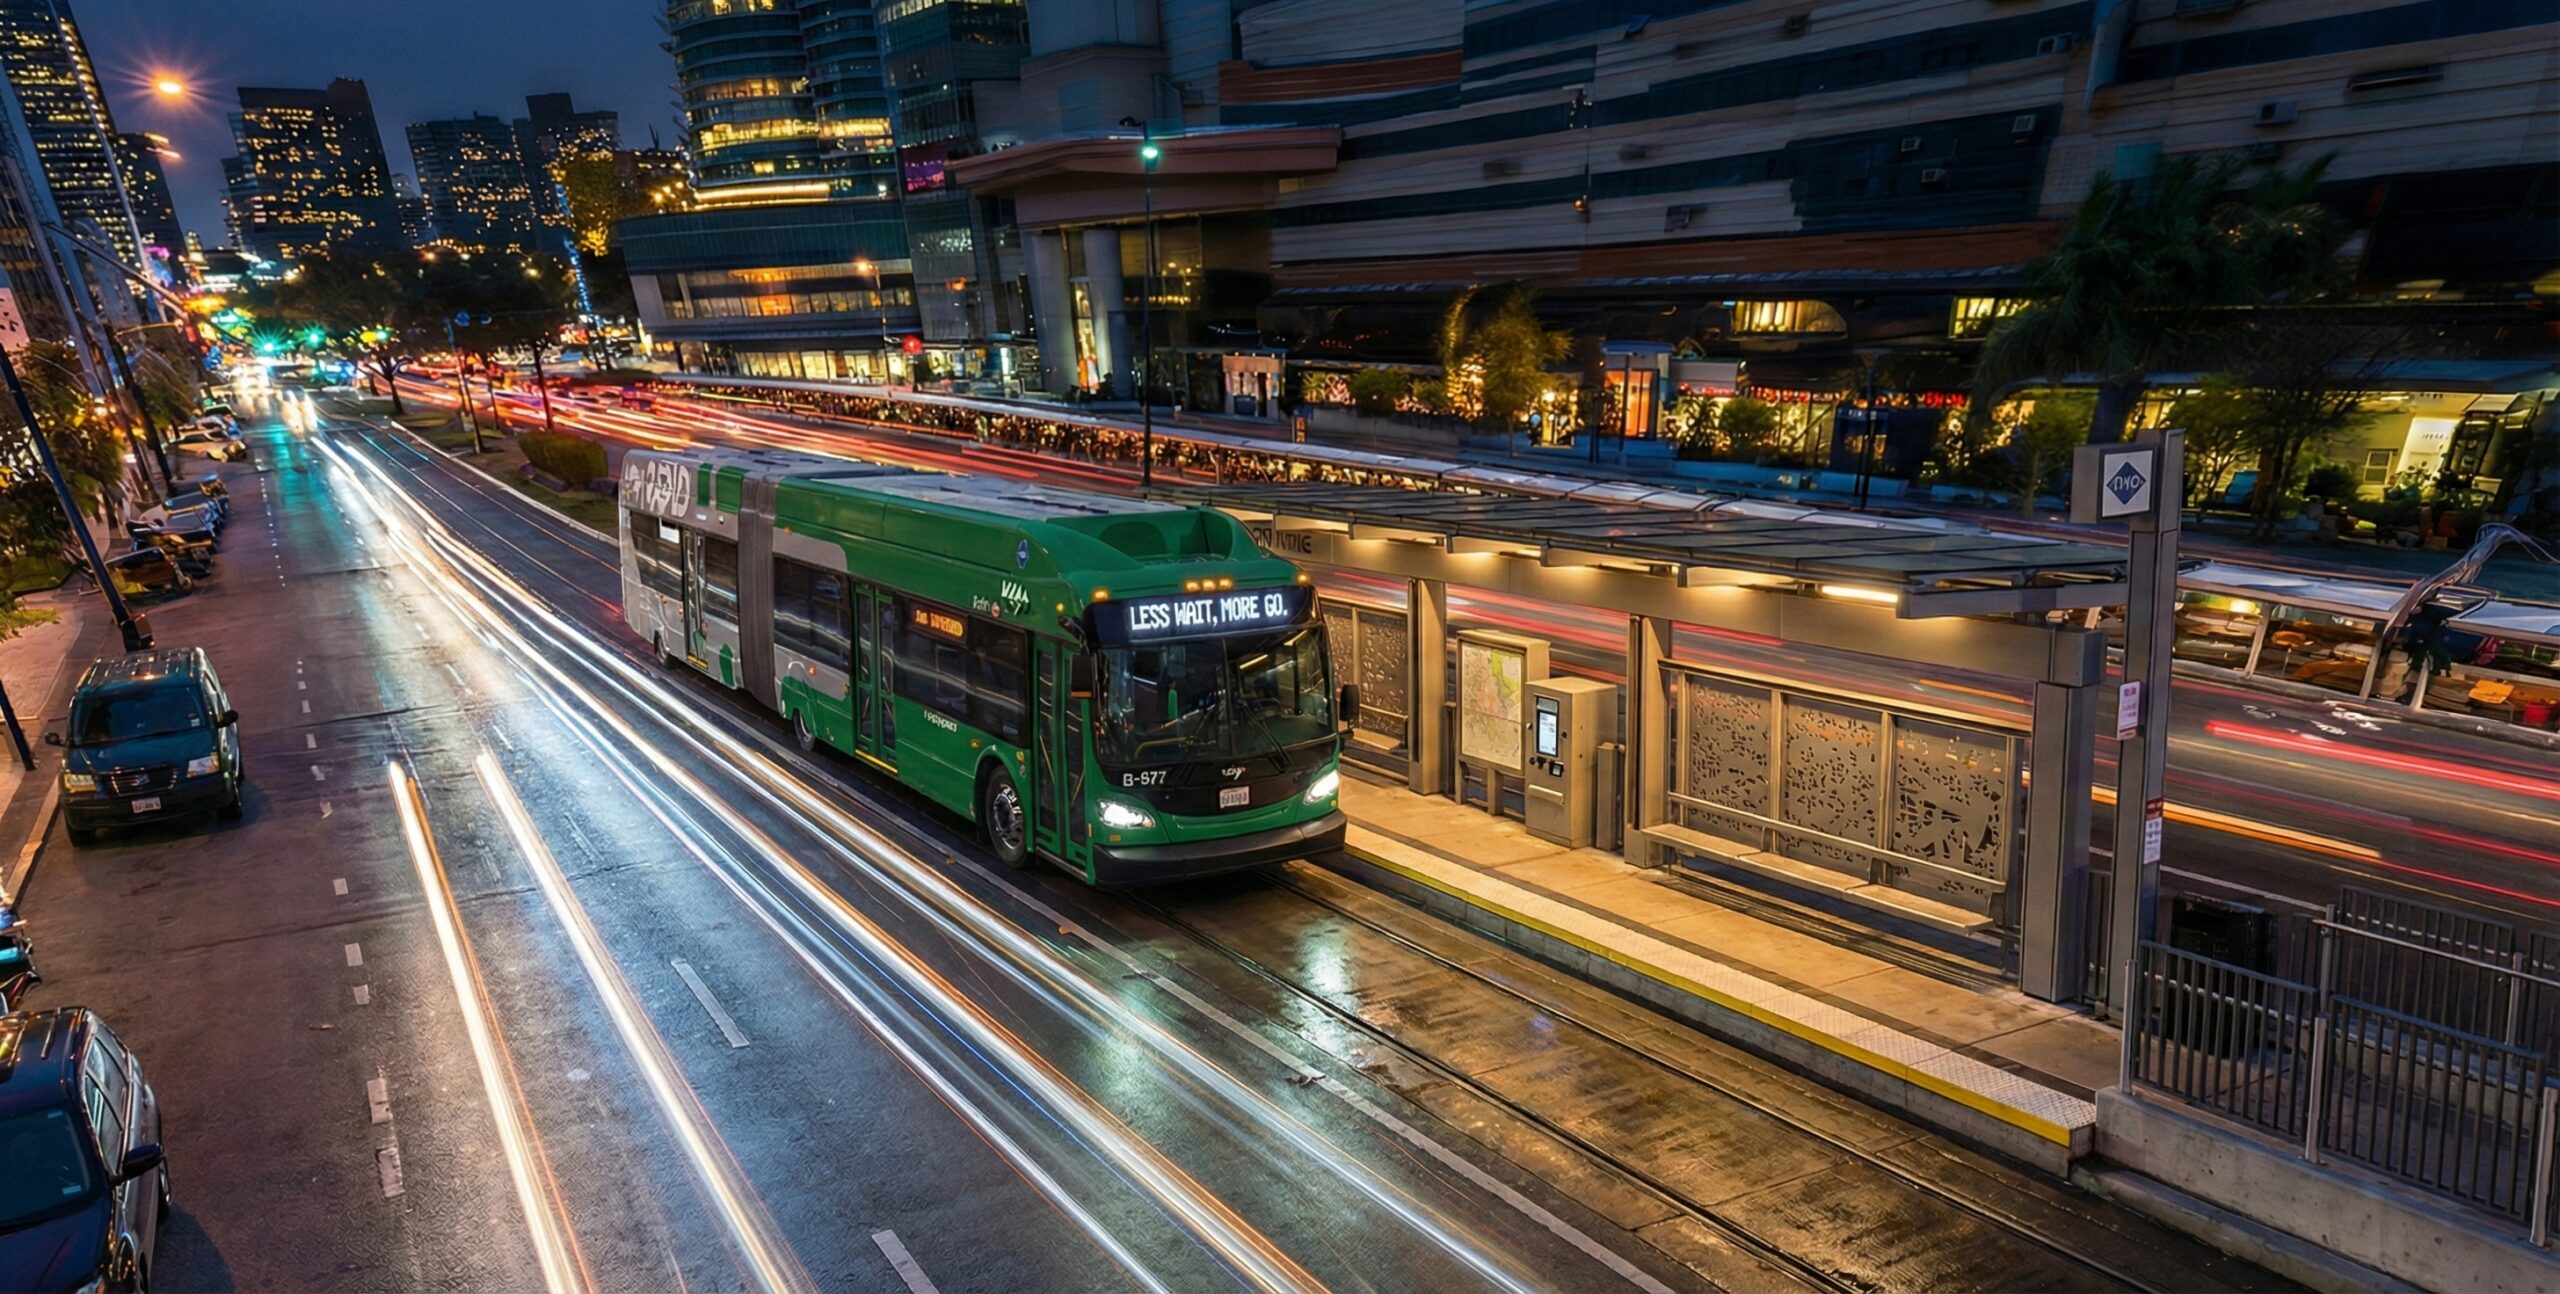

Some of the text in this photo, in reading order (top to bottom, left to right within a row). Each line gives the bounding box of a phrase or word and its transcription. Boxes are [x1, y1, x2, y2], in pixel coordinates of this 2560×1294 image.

[1129, 592, 1288, 631] LESS WAIT, MORE GO.
